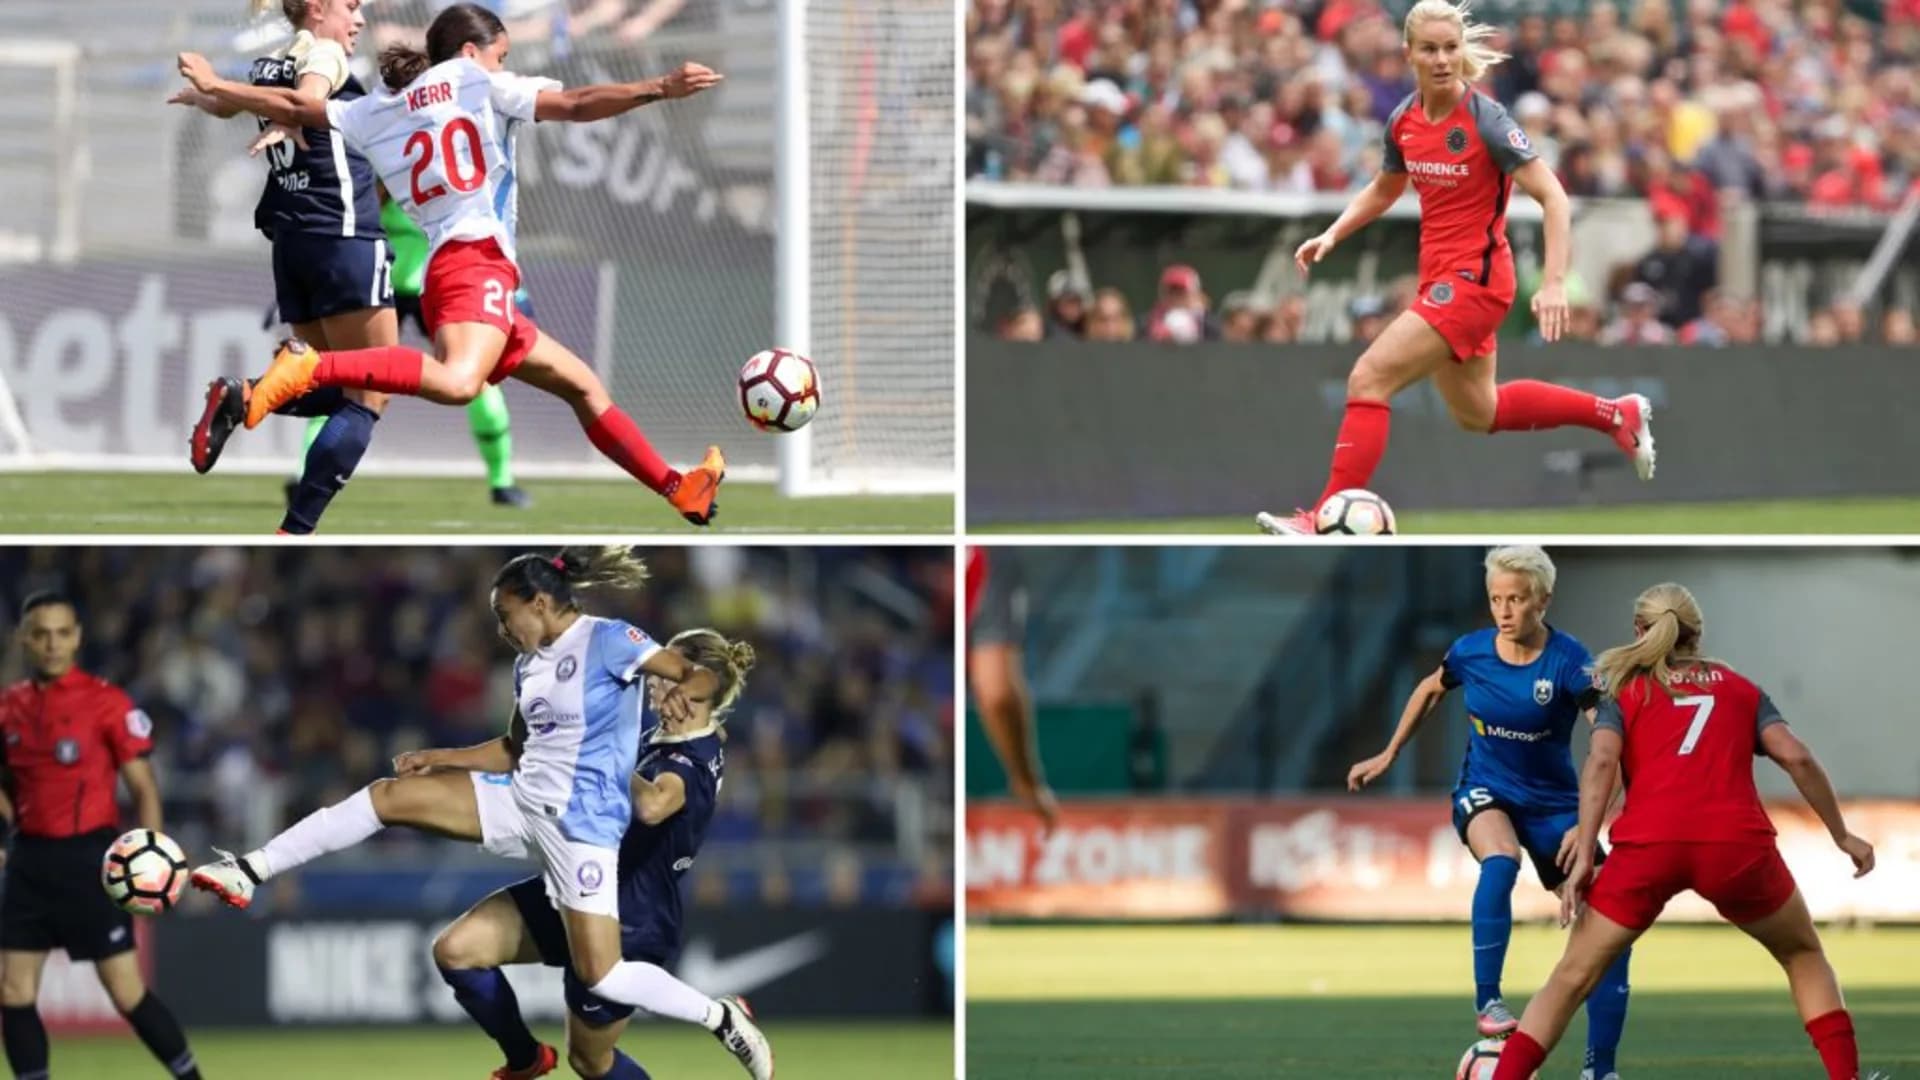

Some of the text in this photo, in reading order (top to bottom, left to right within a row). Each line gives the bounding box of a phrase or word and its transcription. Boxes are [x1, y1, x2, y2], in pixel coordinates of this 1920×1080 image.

[406, 82, 452, 111] KERR
[403, 118, 487, 206] 20
[1405, 160, 1469, 176] OVIDENCE
[1673, 695, 1715, 756] 7
[1460, 787, 1493, 814] 15
[1034, 824, 1207, 884] ZONE
